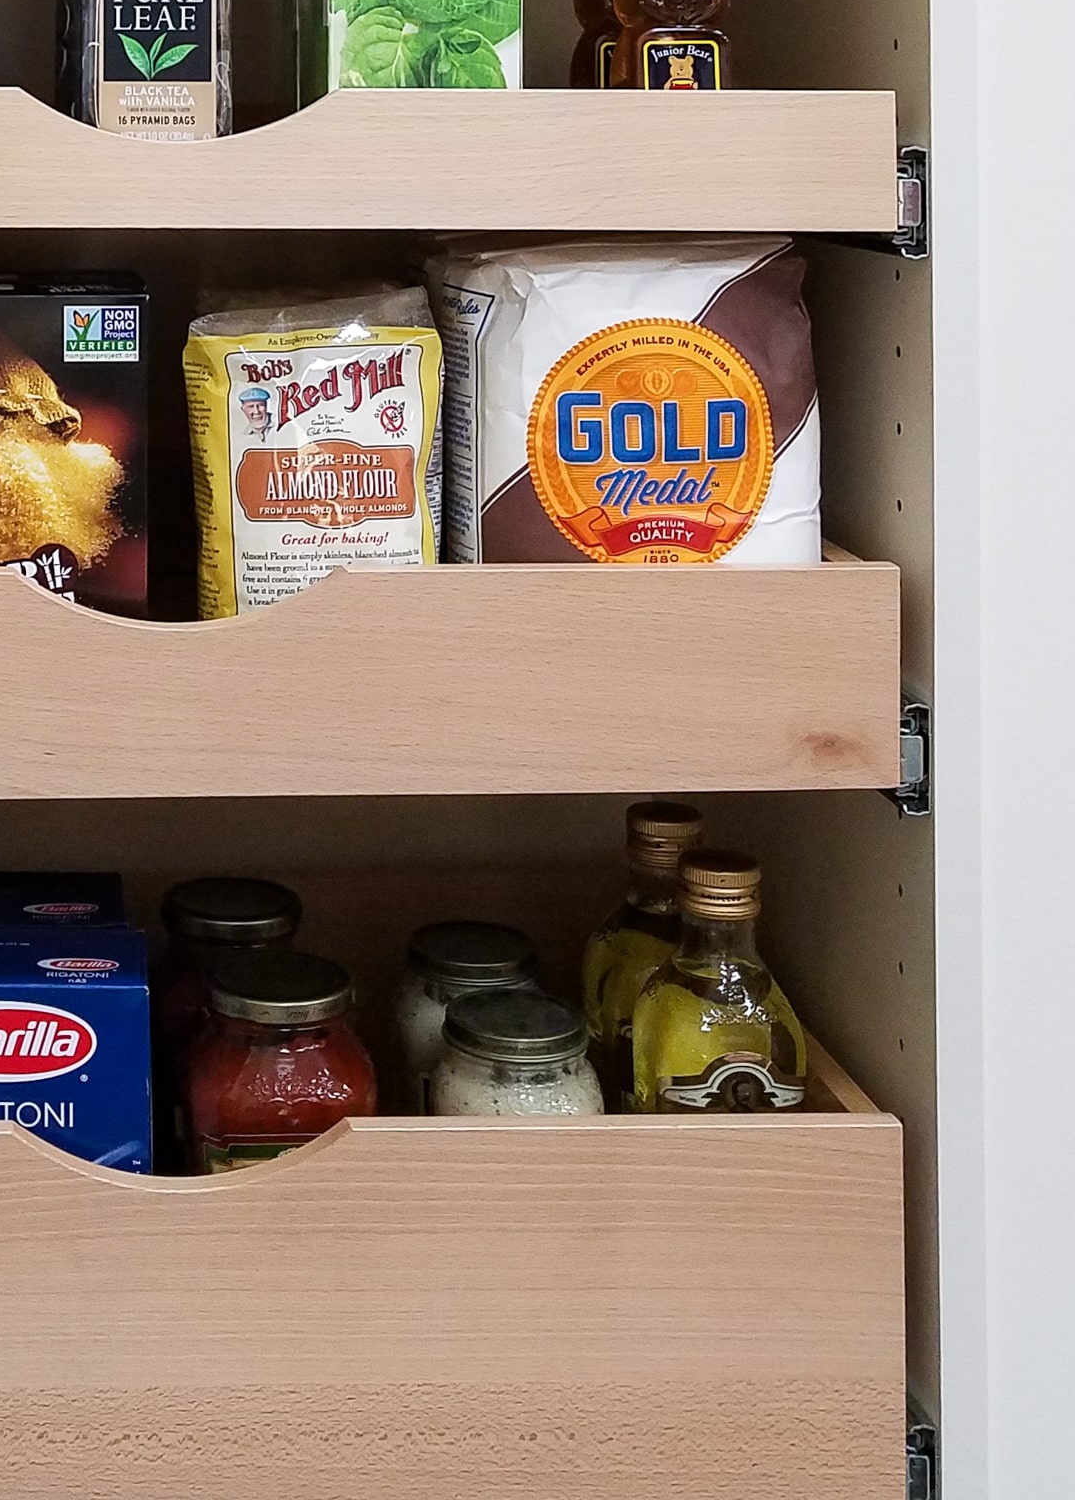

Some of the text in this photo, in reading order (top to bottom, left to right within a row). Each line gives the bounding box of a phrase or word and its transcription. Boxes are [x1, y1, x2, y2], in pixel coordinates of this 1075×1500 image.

[114, 5, 194, 31] LEAF
[651, 45, 709, 62] Junior Bear
[125, 86, 189, 96] BLACK TEA
[119, 97, 195, 106] with VANILLA
[118, 116, 195, 125] 16 PYRAMID BAGS
[105, 310, 134, 320] NON
[104, 320, 135, 330] GMO
[104, 330, 134, 340] Project
[69, 342, 135, 350] VERIFIED
[267, 338, 278, 346] An
[576, 337, 731, 376] EXPERTLY MILLED IN THE USA
[241, 358, 293, 383] Bob's
[276, 366, 342, 432] Red
[342, 348, 405, 413] Mill
[374, 399, 397, 418] GLUTEN
[556, 391, 747, 464] GOLD
[281, 453, 383, 468] SUPER-FINE
[266, 468, 398, 500] ALMOND FLOUR
[596, 467, 717, 515] Medal
[259, 506, 283, 515] FROM
[368, 504, 407, 512] ALMONDS
[638, 521, 685, 530] PREMIUM
[281, 532, 389, 547] Great for baking!
[630, 529, 694, 542] QUALITY
[241, 552, 268, 560] Almond
[270, 551, 289, 560] Flour
[291, 552, 297, 560] is
[299, 552, 322, 562] simply
[355, 549, 387, 558] blanched
[644, 555, 678, 563] 1880
[246, 563, 263, 572] have
[264, 562, 281, 572] been
[242, 574, 301, 584] free and contains
[246, 586, 260, 594] Use
[261, 586, 267, 594] it
[276, 587, 295, 596] grain
[57, 960, 113, 969] Barilla
